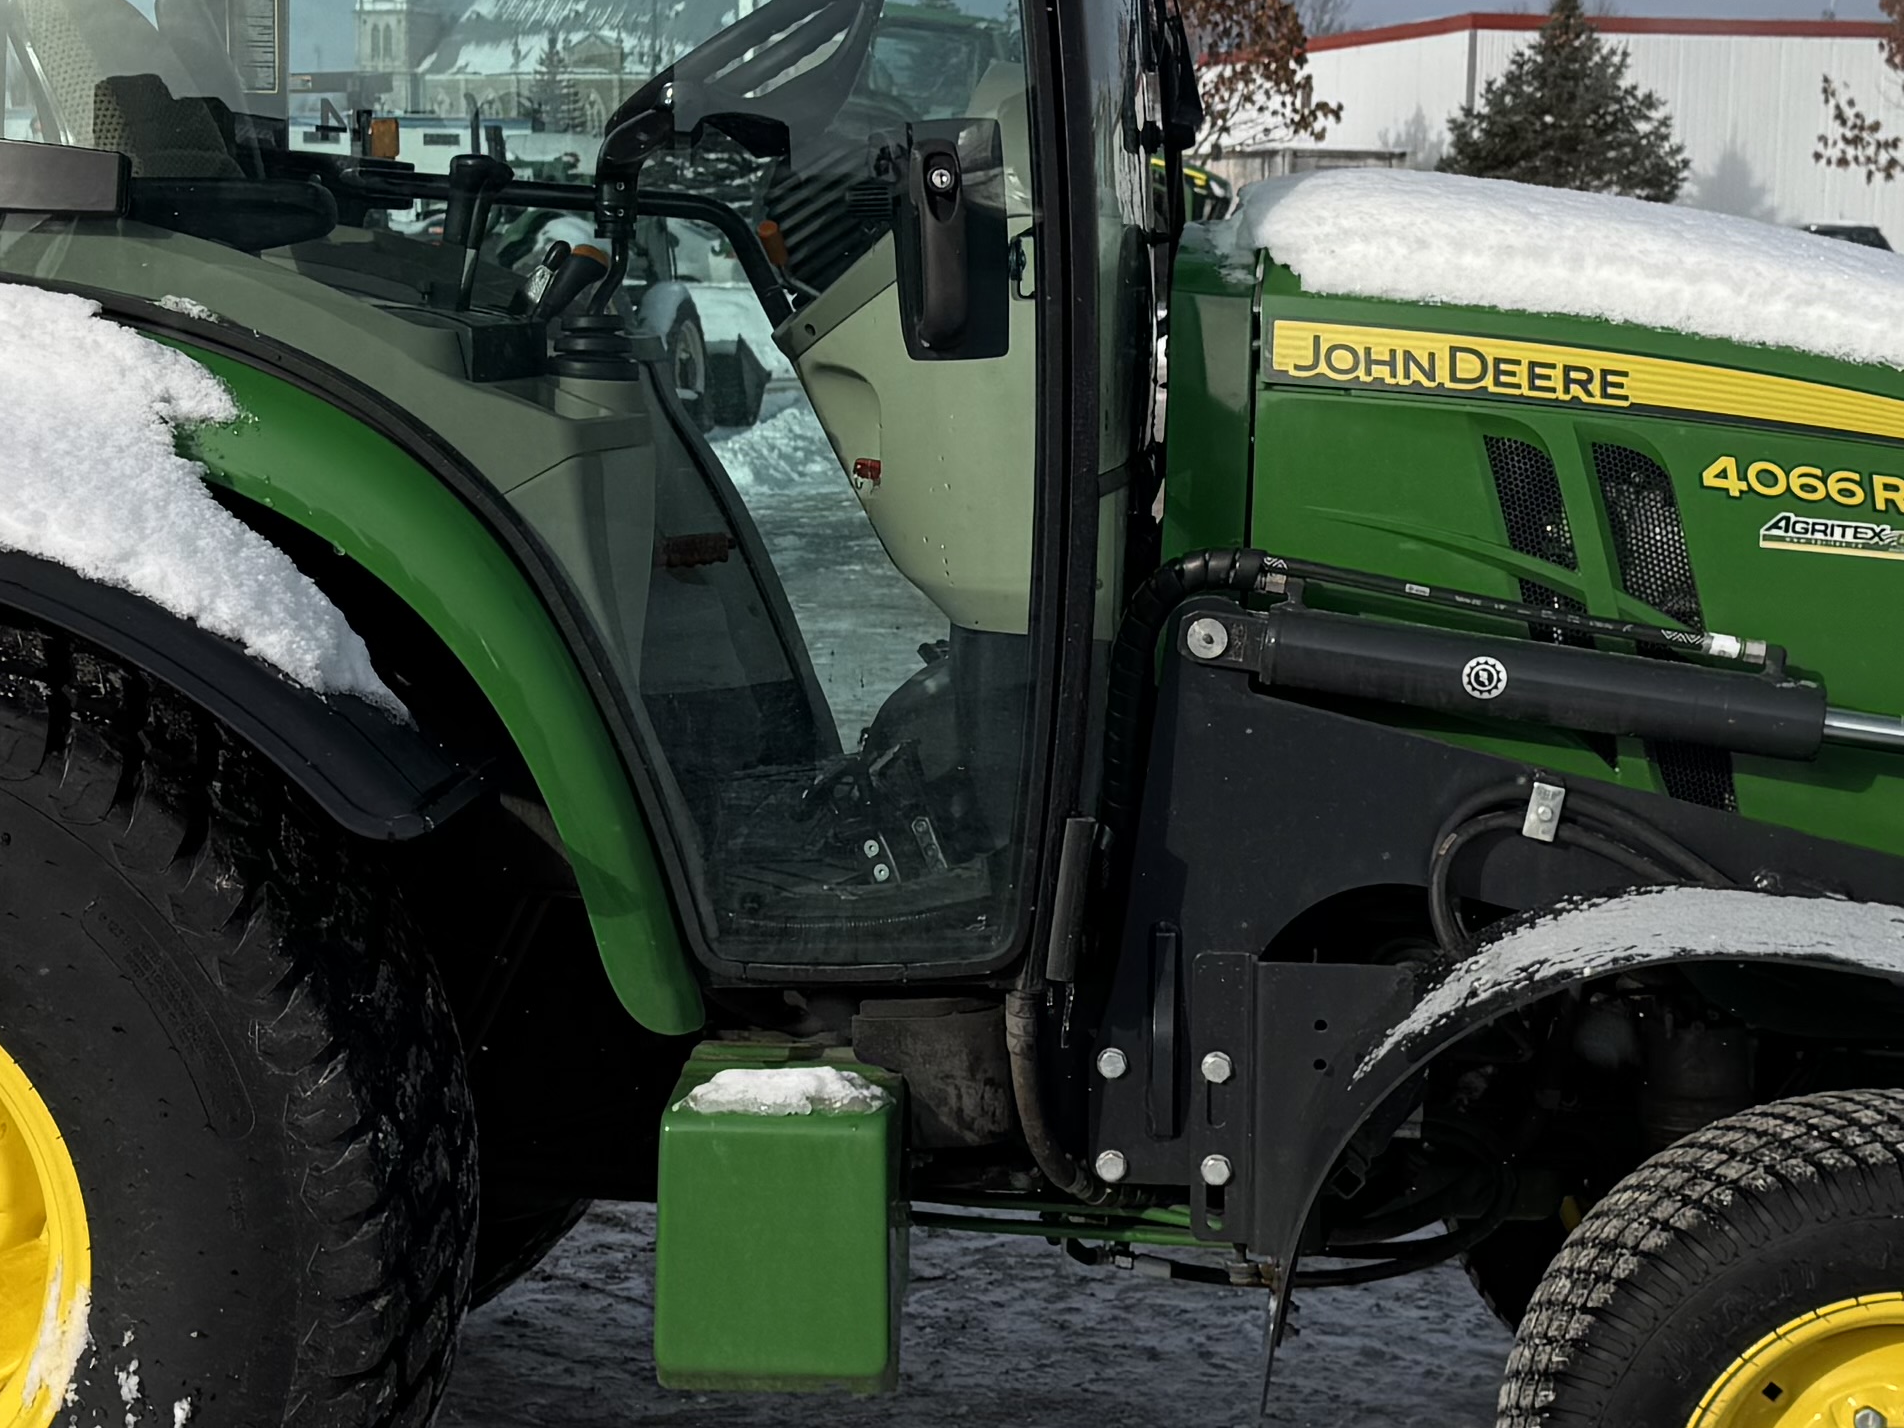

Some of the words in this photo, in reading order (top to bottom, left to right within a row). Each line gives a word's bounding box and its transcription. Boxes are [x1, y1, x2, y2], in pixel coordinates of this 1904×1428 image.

[1293, 333, 1438, 384] JOHN
[1448, 344, 1631, 403] DEERE
[1764, 514, 1887, 543] AGRITEX
